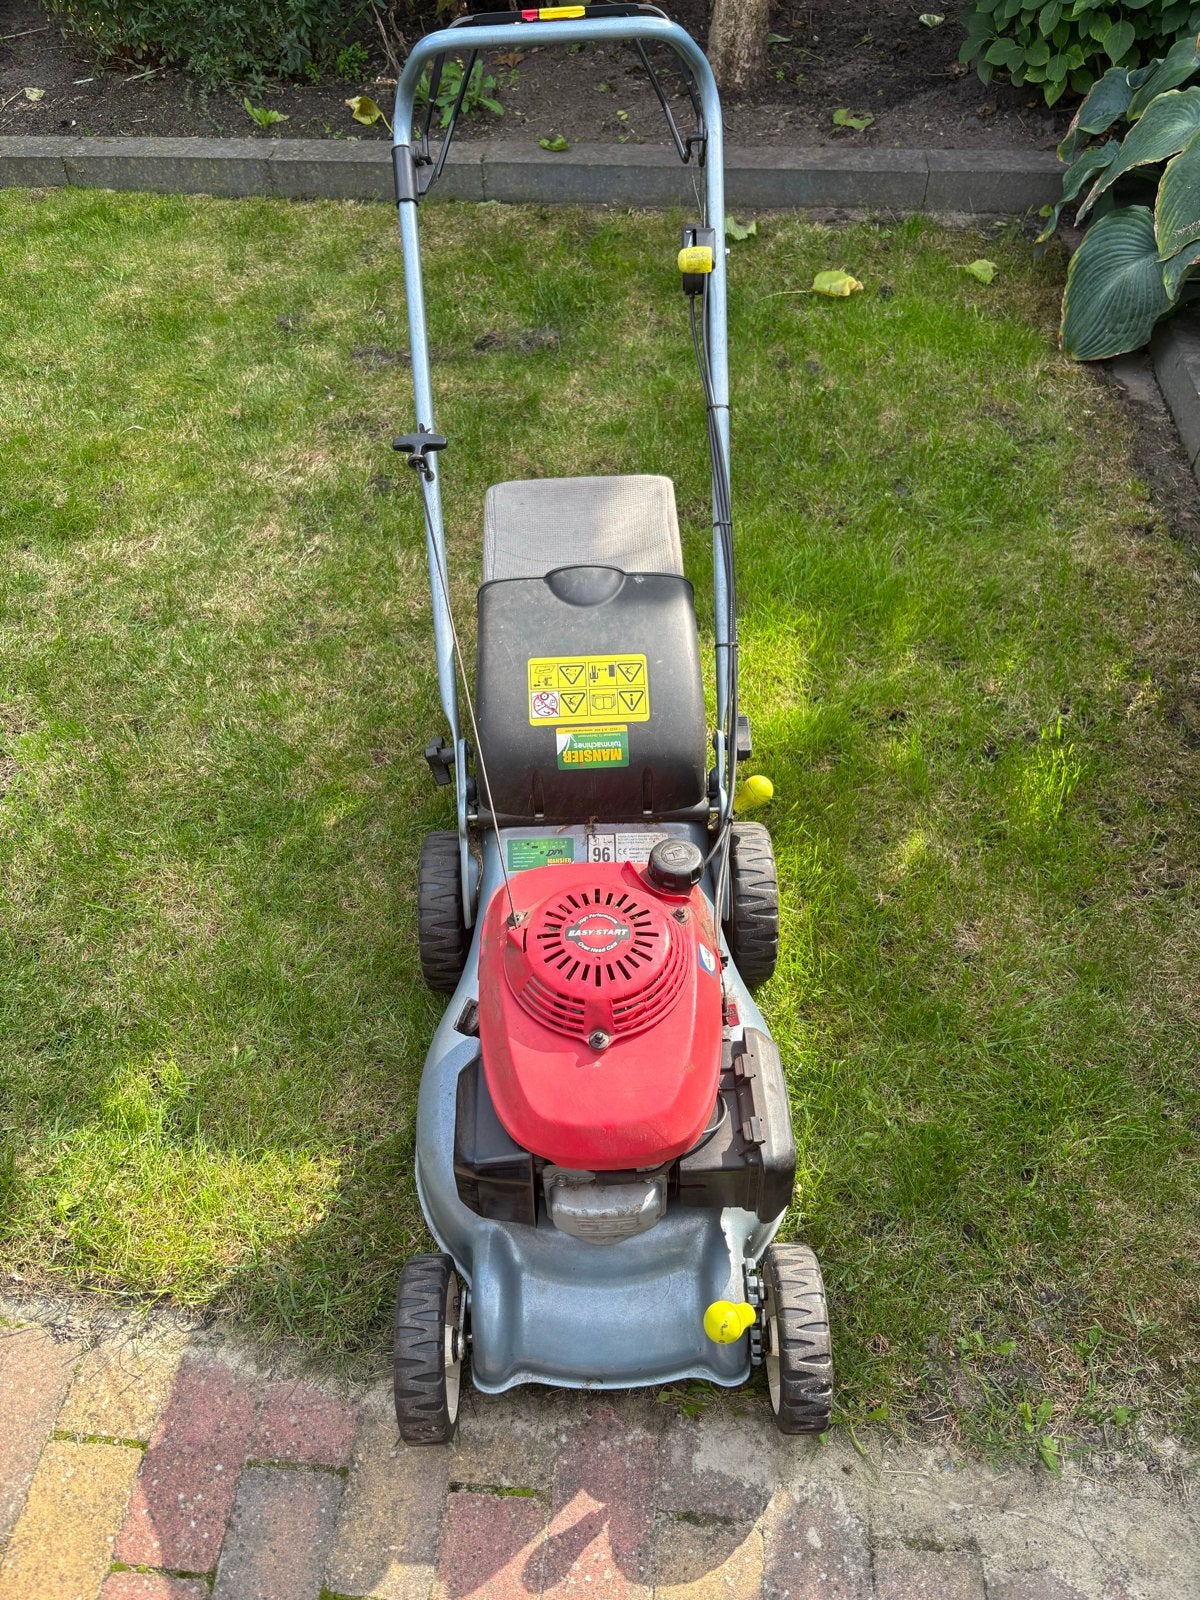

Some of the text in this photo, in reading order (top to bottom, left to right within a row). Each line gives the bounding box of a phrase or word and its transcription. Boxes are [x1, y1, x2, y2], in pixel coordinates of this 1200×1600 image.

[593, 847, 610, 862] 96
[568, 929, 594, 937] EASY
[578, 941, 591, 951] Over
